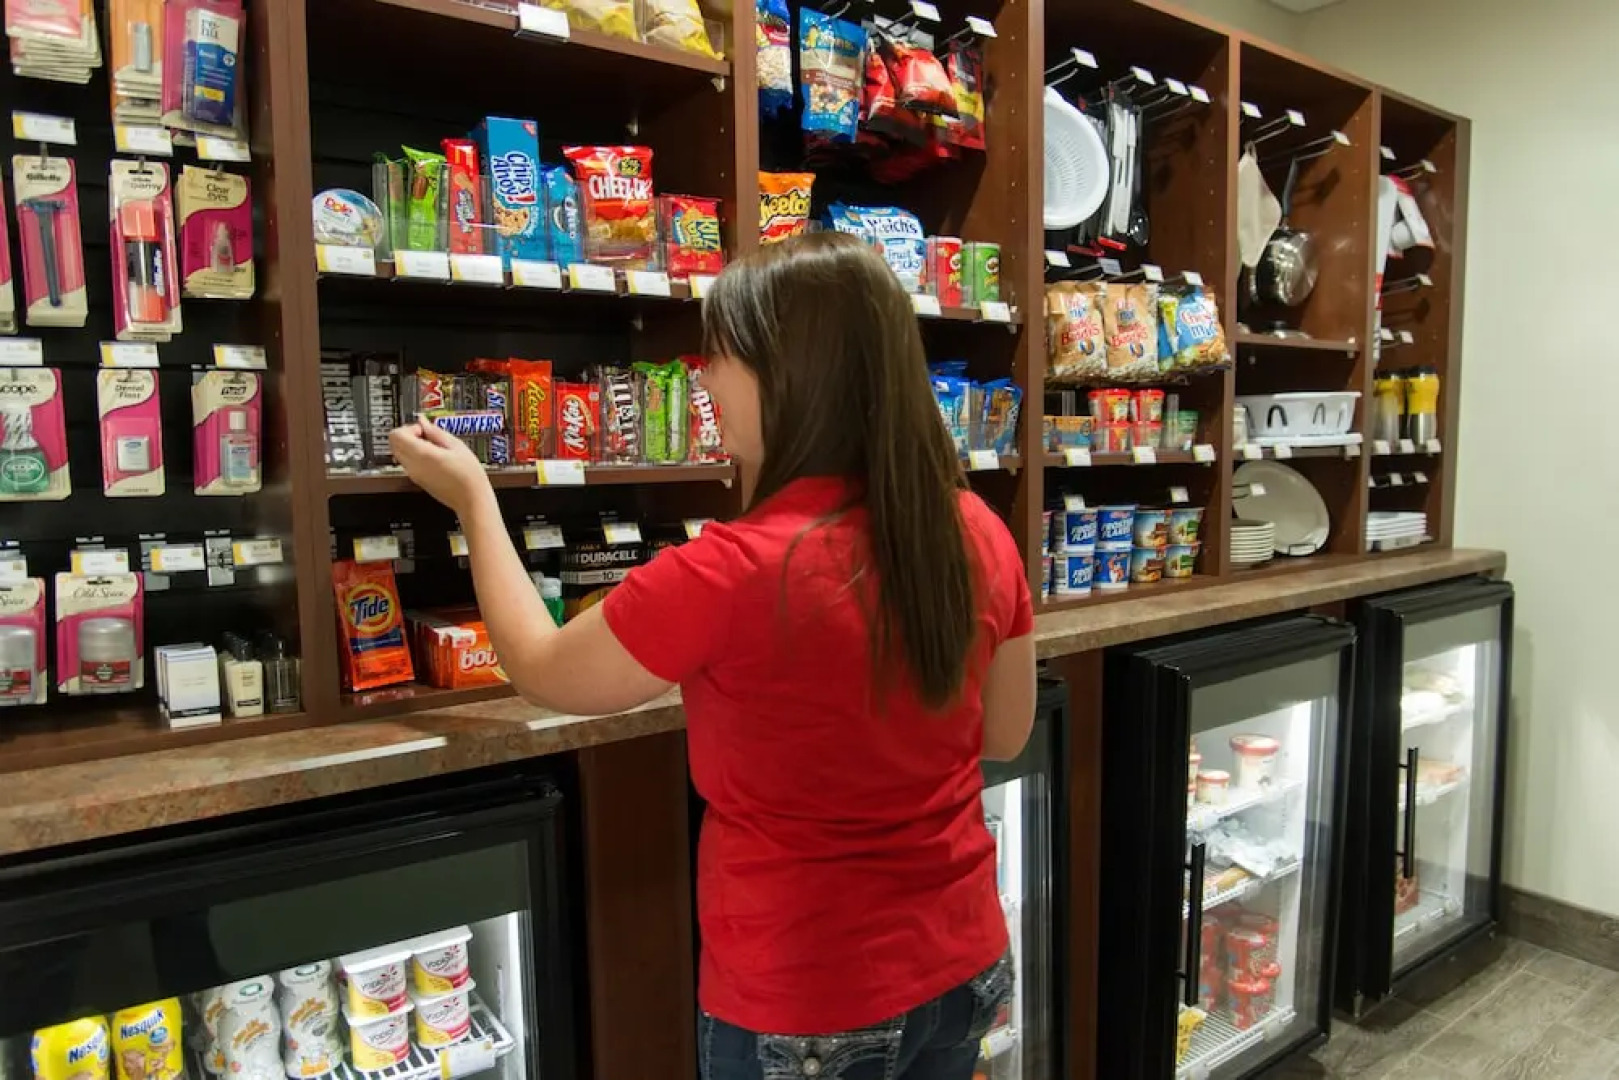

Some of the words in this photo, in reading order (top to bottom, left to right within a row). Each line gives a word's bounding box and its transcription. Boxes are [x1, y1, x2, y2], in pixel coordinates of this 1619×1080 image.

[26, 173, 61, 181] Gillette
[507, 153, 533, 201] Chips
[207, 183, 229, 193] Clear
[760, 190, 812, 229] heetos
[436, 415, 502, 434] SNICKERS
[580, 550, 638, 564] DURACELL
[602, 571, 614, 581] 10
[73, 587, 98, 598] Old
[99, 587, 126, 598] Spice
[348, 592, 389, 627] Tide
[460, 648, 498, 671] bou
[120, 1009, 163, 1039] Nesquik
